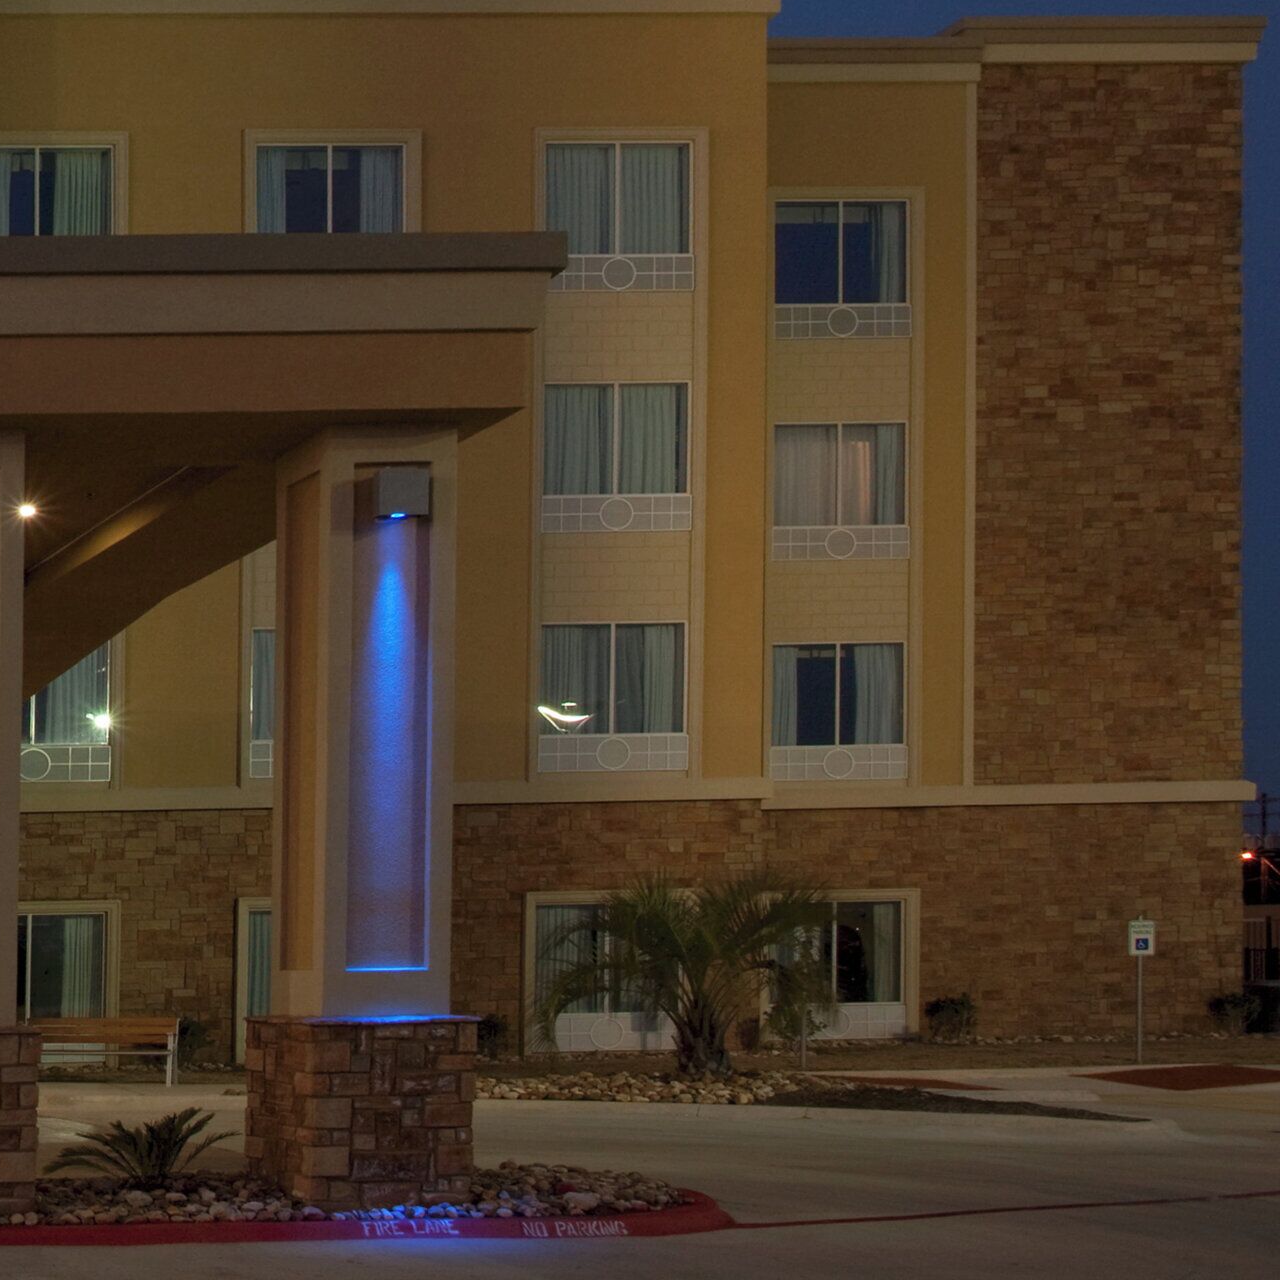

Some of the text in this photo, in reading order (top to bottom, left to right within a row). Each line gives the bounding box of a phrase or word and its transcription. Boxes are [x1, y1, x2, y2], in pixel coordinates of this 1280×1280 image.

[361, 1219, 459, 1237] FIRE LANE
[522, 1220, 629, 1237] NO PARKING
